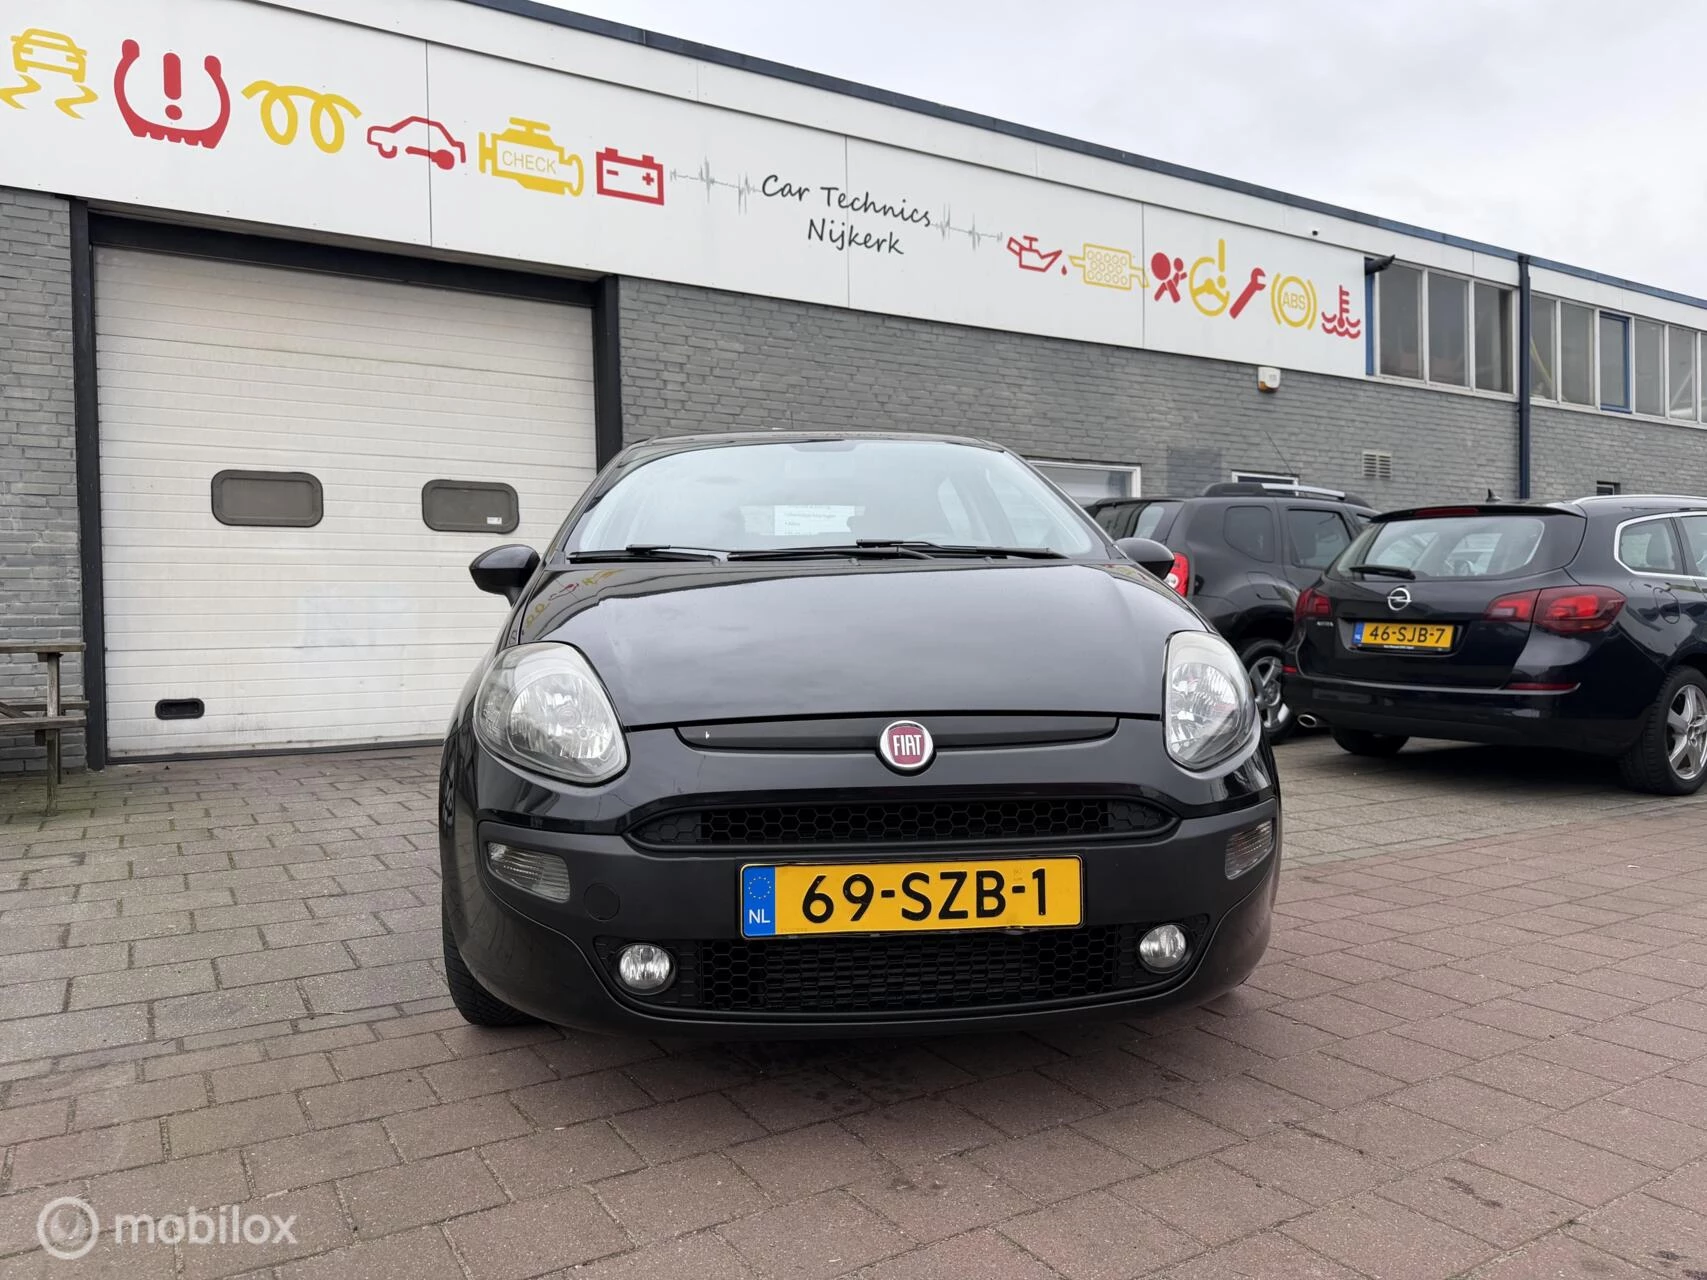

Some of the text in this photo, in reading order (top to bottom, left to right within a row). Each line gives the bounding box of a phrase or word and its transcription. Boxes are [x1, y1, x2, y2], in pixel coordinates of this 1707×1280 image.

[502, 150, 557, 175] CHECK
[761, 174, 931, 228] Car Technics
[807, 217, 905, 255] Nijkerk
[1282, 291, 1306, 311] ABS
[1369, 625, 1447, 645] 46-SJB-7
[892, 734, 922, 757] FIAT
[802, 867, 1047, 924] 69-SZB-1
[748, 909, 771, 925] NL
